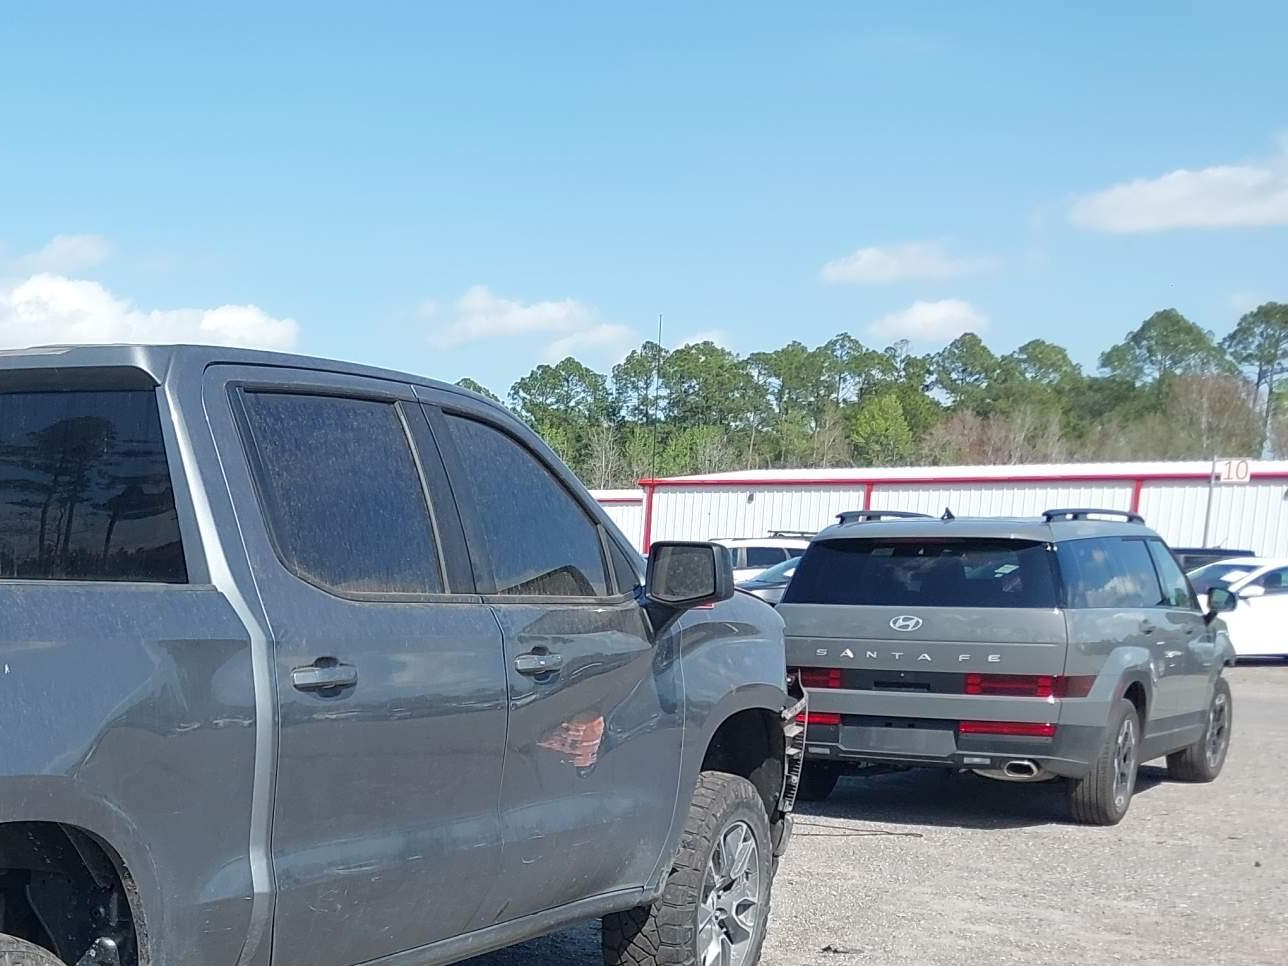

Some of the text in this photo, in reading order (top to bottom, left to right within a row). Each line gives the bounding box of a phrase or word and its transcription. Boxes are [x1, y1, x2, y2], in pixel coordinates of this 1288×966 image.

[1223, 459, 1249, 481] 10
[815, 647, 1002, 663] SANTA FE
